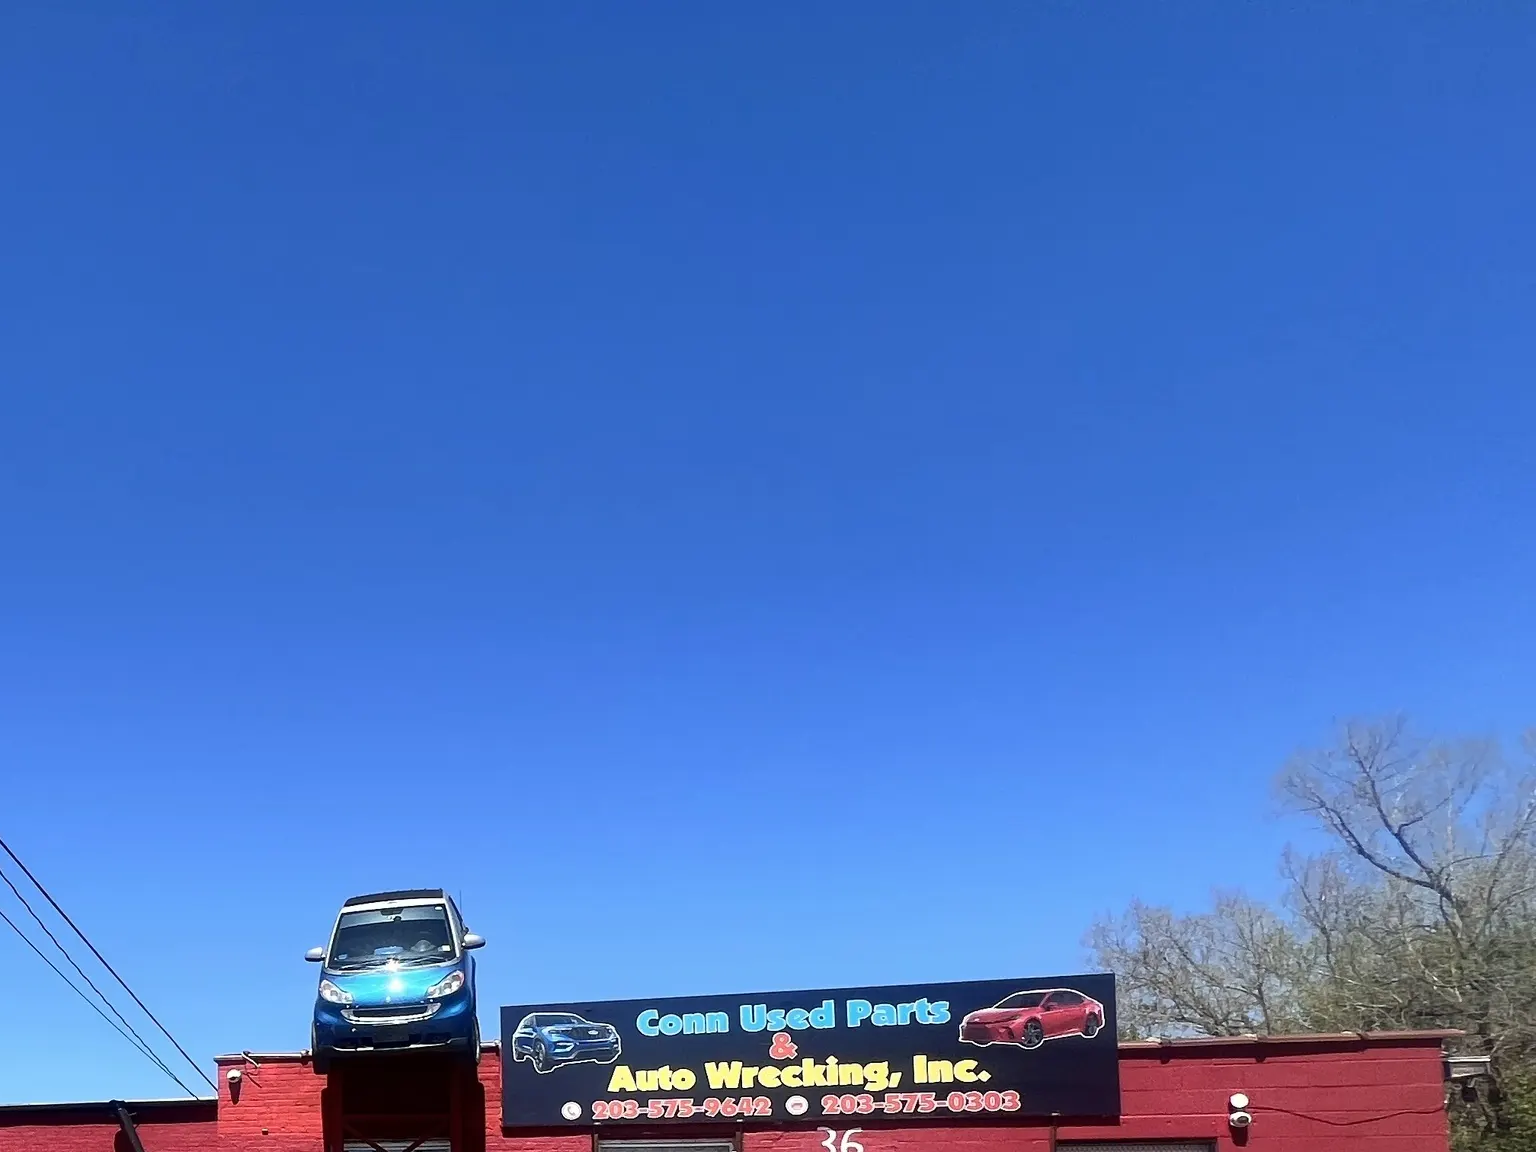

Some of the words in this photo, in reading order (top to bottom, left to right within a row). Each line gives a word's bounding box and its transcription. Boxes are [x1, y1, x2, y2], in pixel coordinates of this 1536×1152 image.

[636, 1008, 729, 1037] Conn
[739, 1000, 836, 1032] Used
[846, 998, 952, 1028] Parts
[769, 1032, 798, 1060] &
[607, 1065, 696, 1092] Auto
[704, 1055, 902, 1091] Wrecking,
[913, 1054, 992, 1084] Inc.
[592, 1096, 773, 1120] 203-575-9642
[821, 1091, 1021, 1115] 203-575-0303
